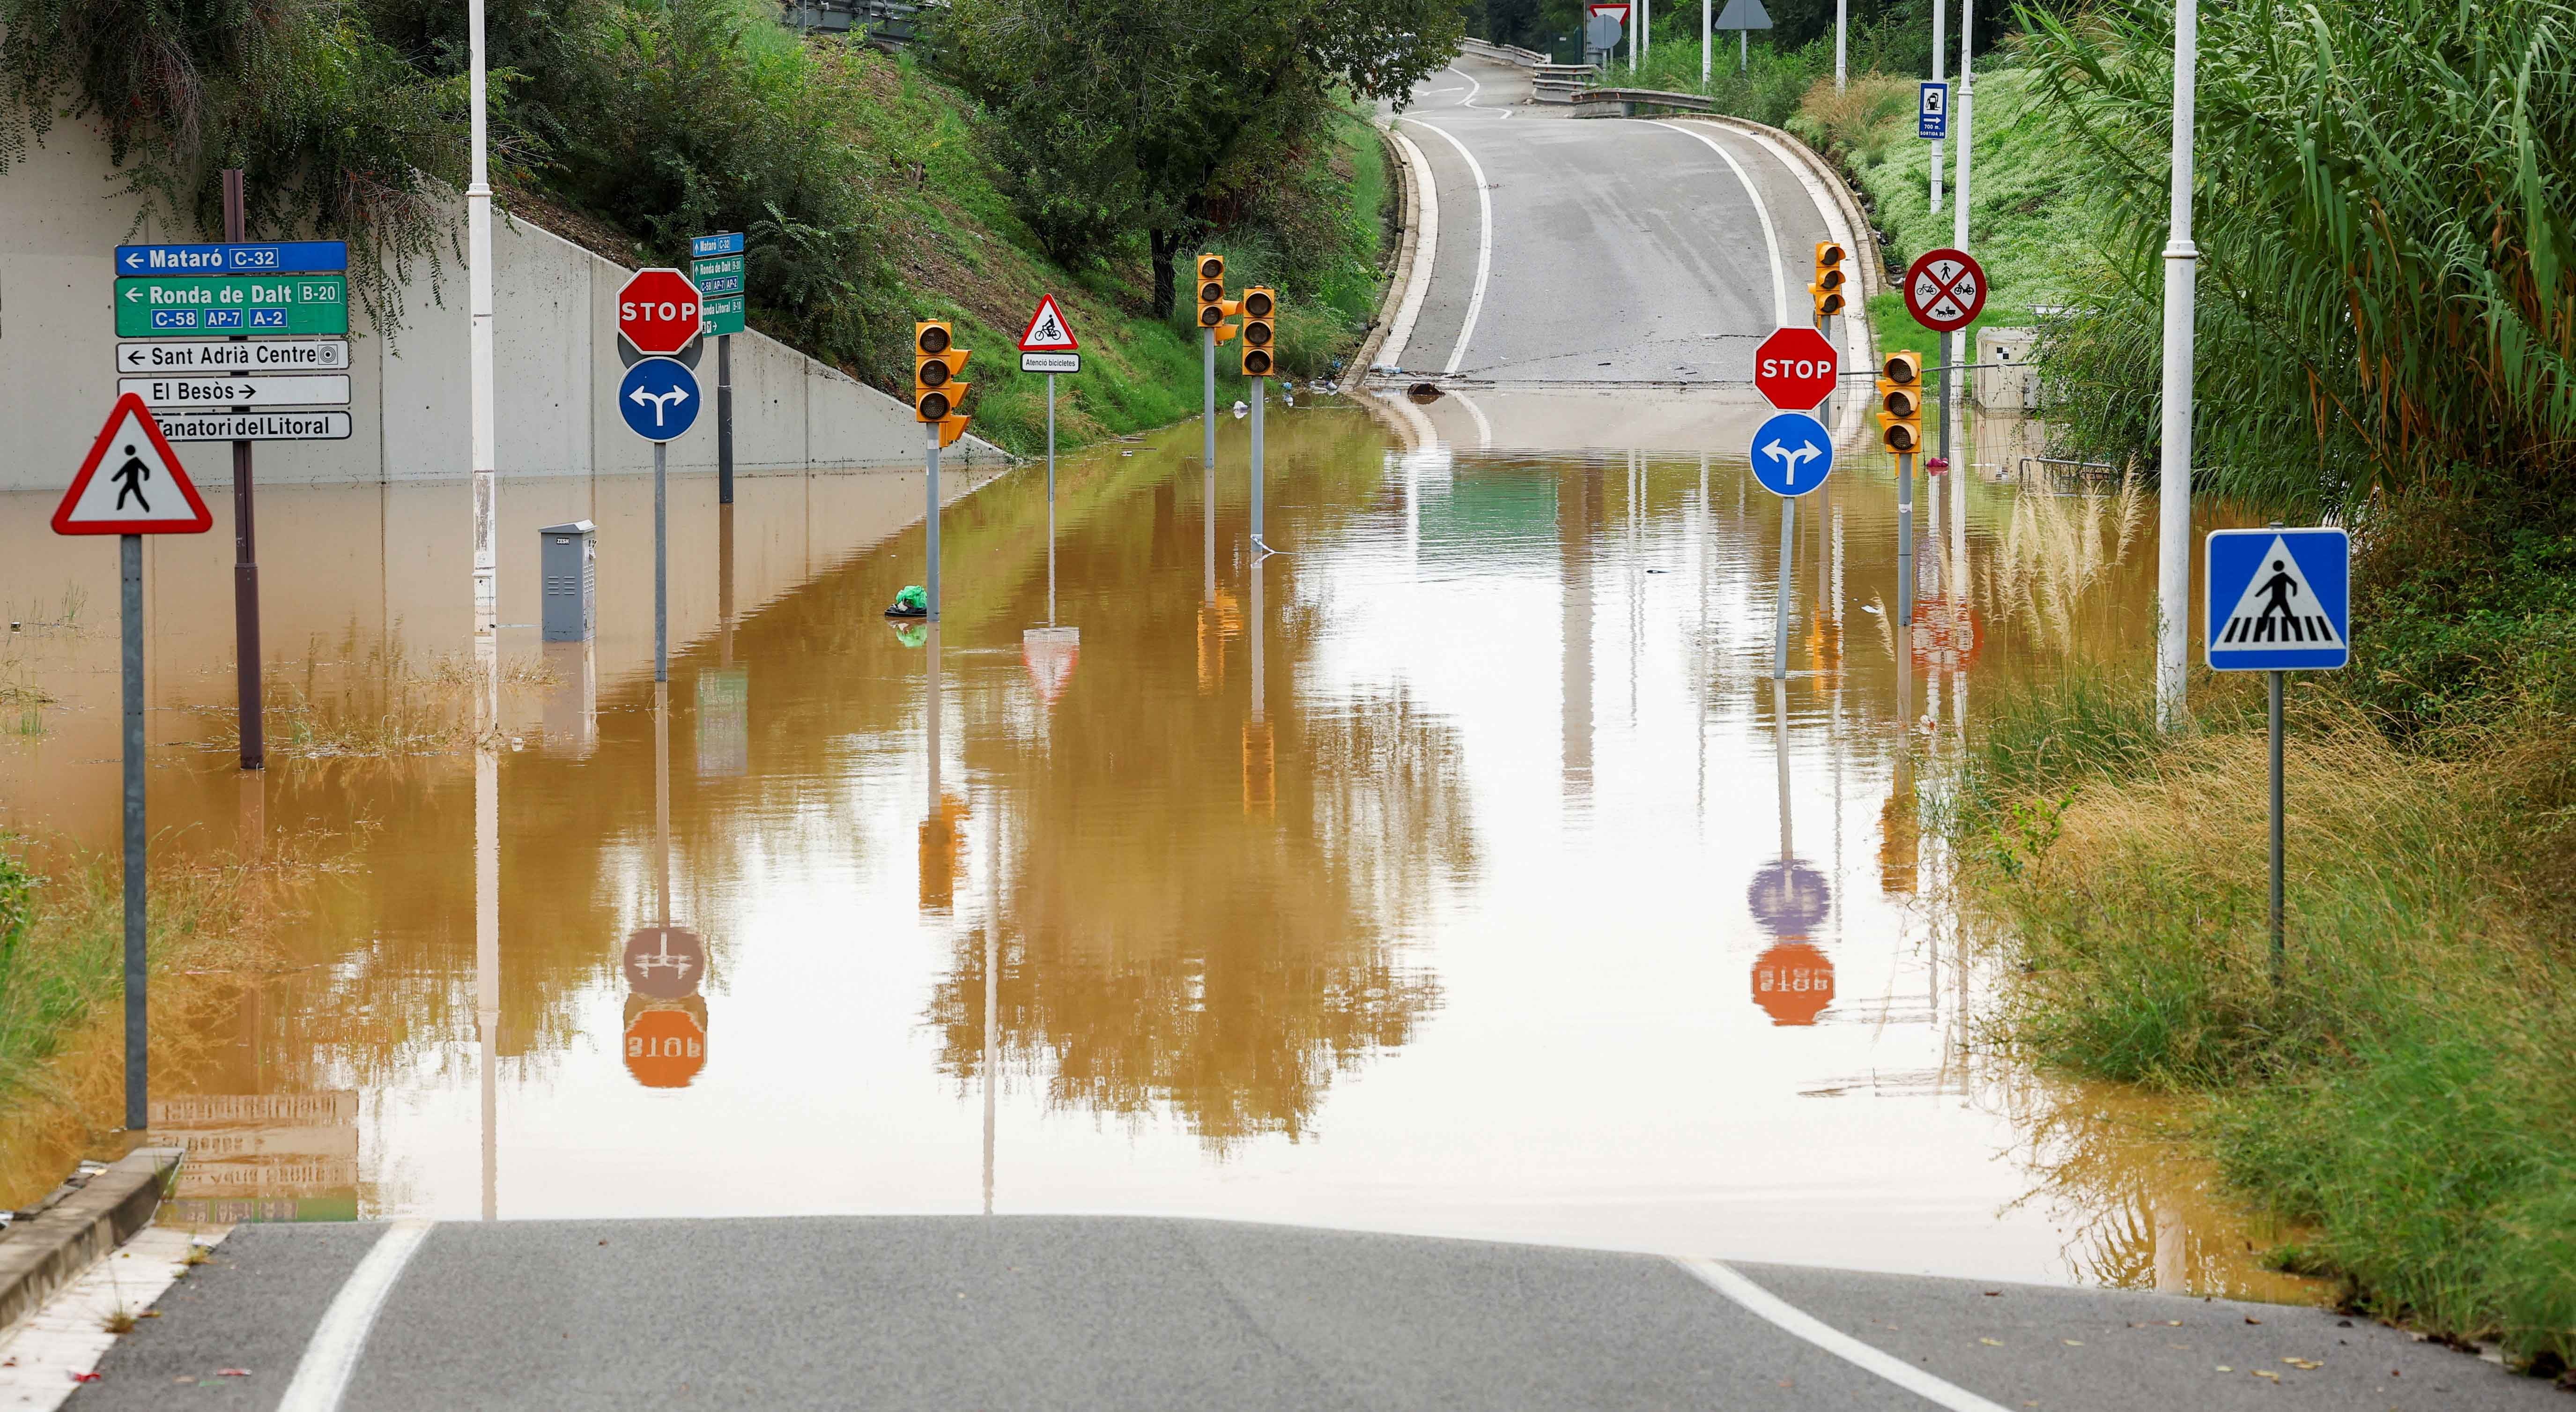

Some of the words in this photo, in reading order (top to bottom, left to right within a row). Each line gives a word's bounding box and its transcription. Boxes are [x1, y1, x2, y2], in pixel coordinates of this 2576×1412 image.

[700, 238, 717, 252] Mataró
[719, 239, 729, 249] C-32
[149, 248, 222, 268] Mataró
[235, 251, 274, 266] C-32
[700, 262, 714, 275] Ronda
[715, 262, 721, 273] de
[721, 260, 731, 272] Dalt
[701, 282, 711, 291] C-58
[714, 280, 724, 290] AP-7
[727, 278, 737, 289] AP-2
[150, 286, 212, 305] Ronda
[220, 285, 244, 303] de
[252, 284, 292, 302] Dalt
[303, 286, 336, 301] B-20
[621, 302, 696, 321] STOP
[715, 301, 730, 314] Litoral
[155, 312, 196, 327] C-58
[207, 311, 240, 326] AP-7
[253, 311, 283, 325] A-2
[152, 348, 192, 365] Sant
[201, 345, 249, 364] Adrià
[257, 346, 316, 364] Centre
[1761, 359, 1831, 379] STOP
[153, 382, 169, 400] El
[178, 382, 234, 400] Besòs
[235, 417, 263, 435] del
[268, 416, 329, 435] Litoral
